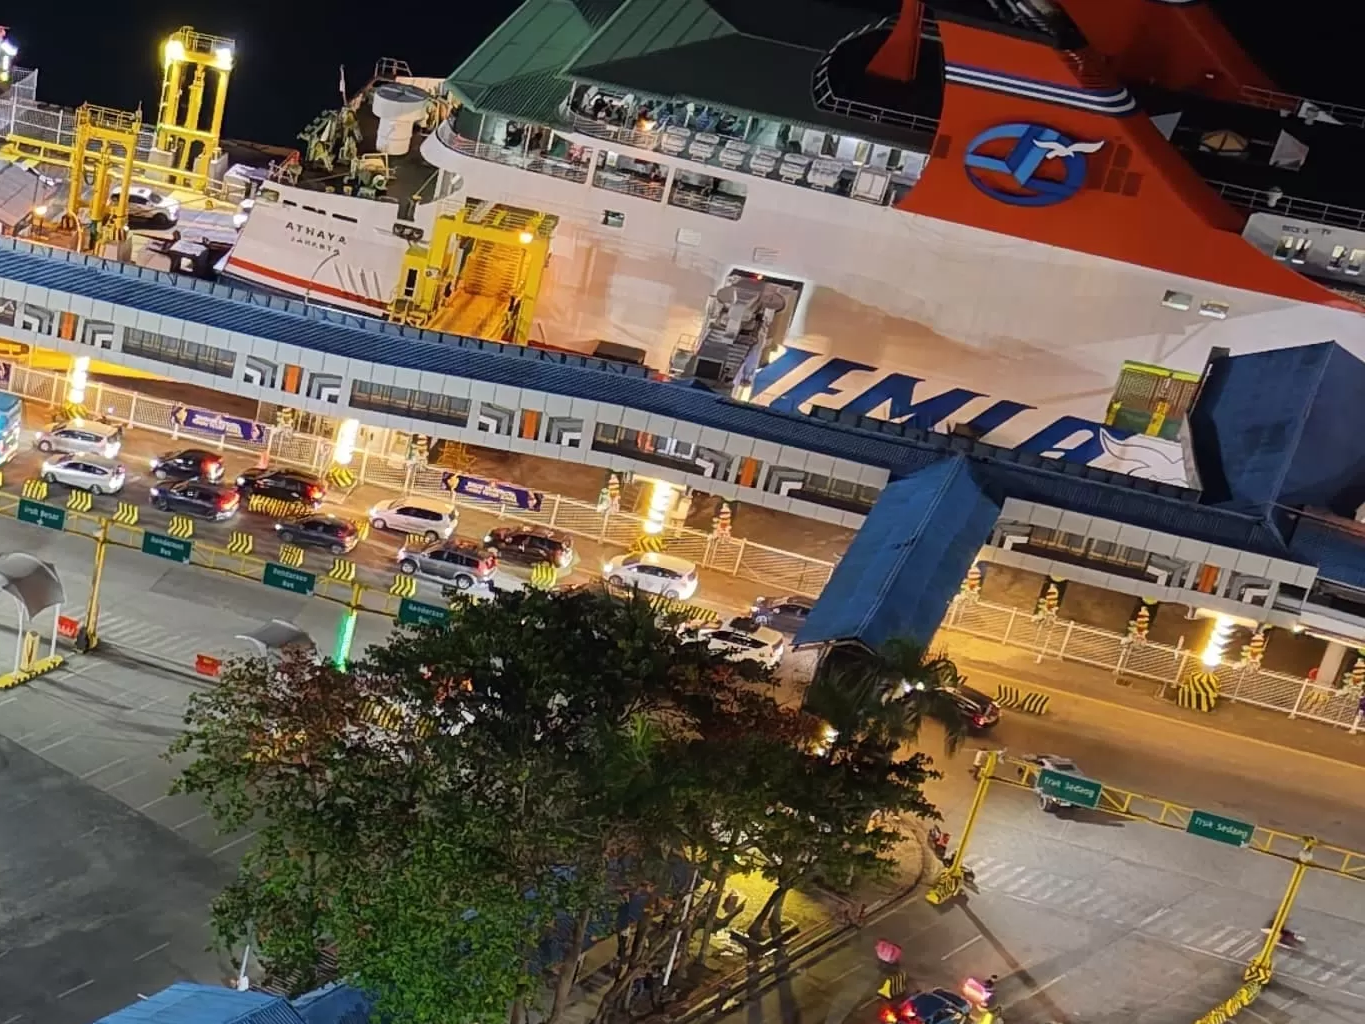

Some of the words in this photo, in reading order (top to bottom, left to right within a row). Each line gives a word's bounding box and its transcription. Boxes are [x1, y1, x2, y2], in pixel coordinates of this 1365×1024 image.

[285, 221, 347, 245] ATHAYA
[1064, 781, 1095, 799] Sedang
[1216, 823, 1248, 840] Sedang
